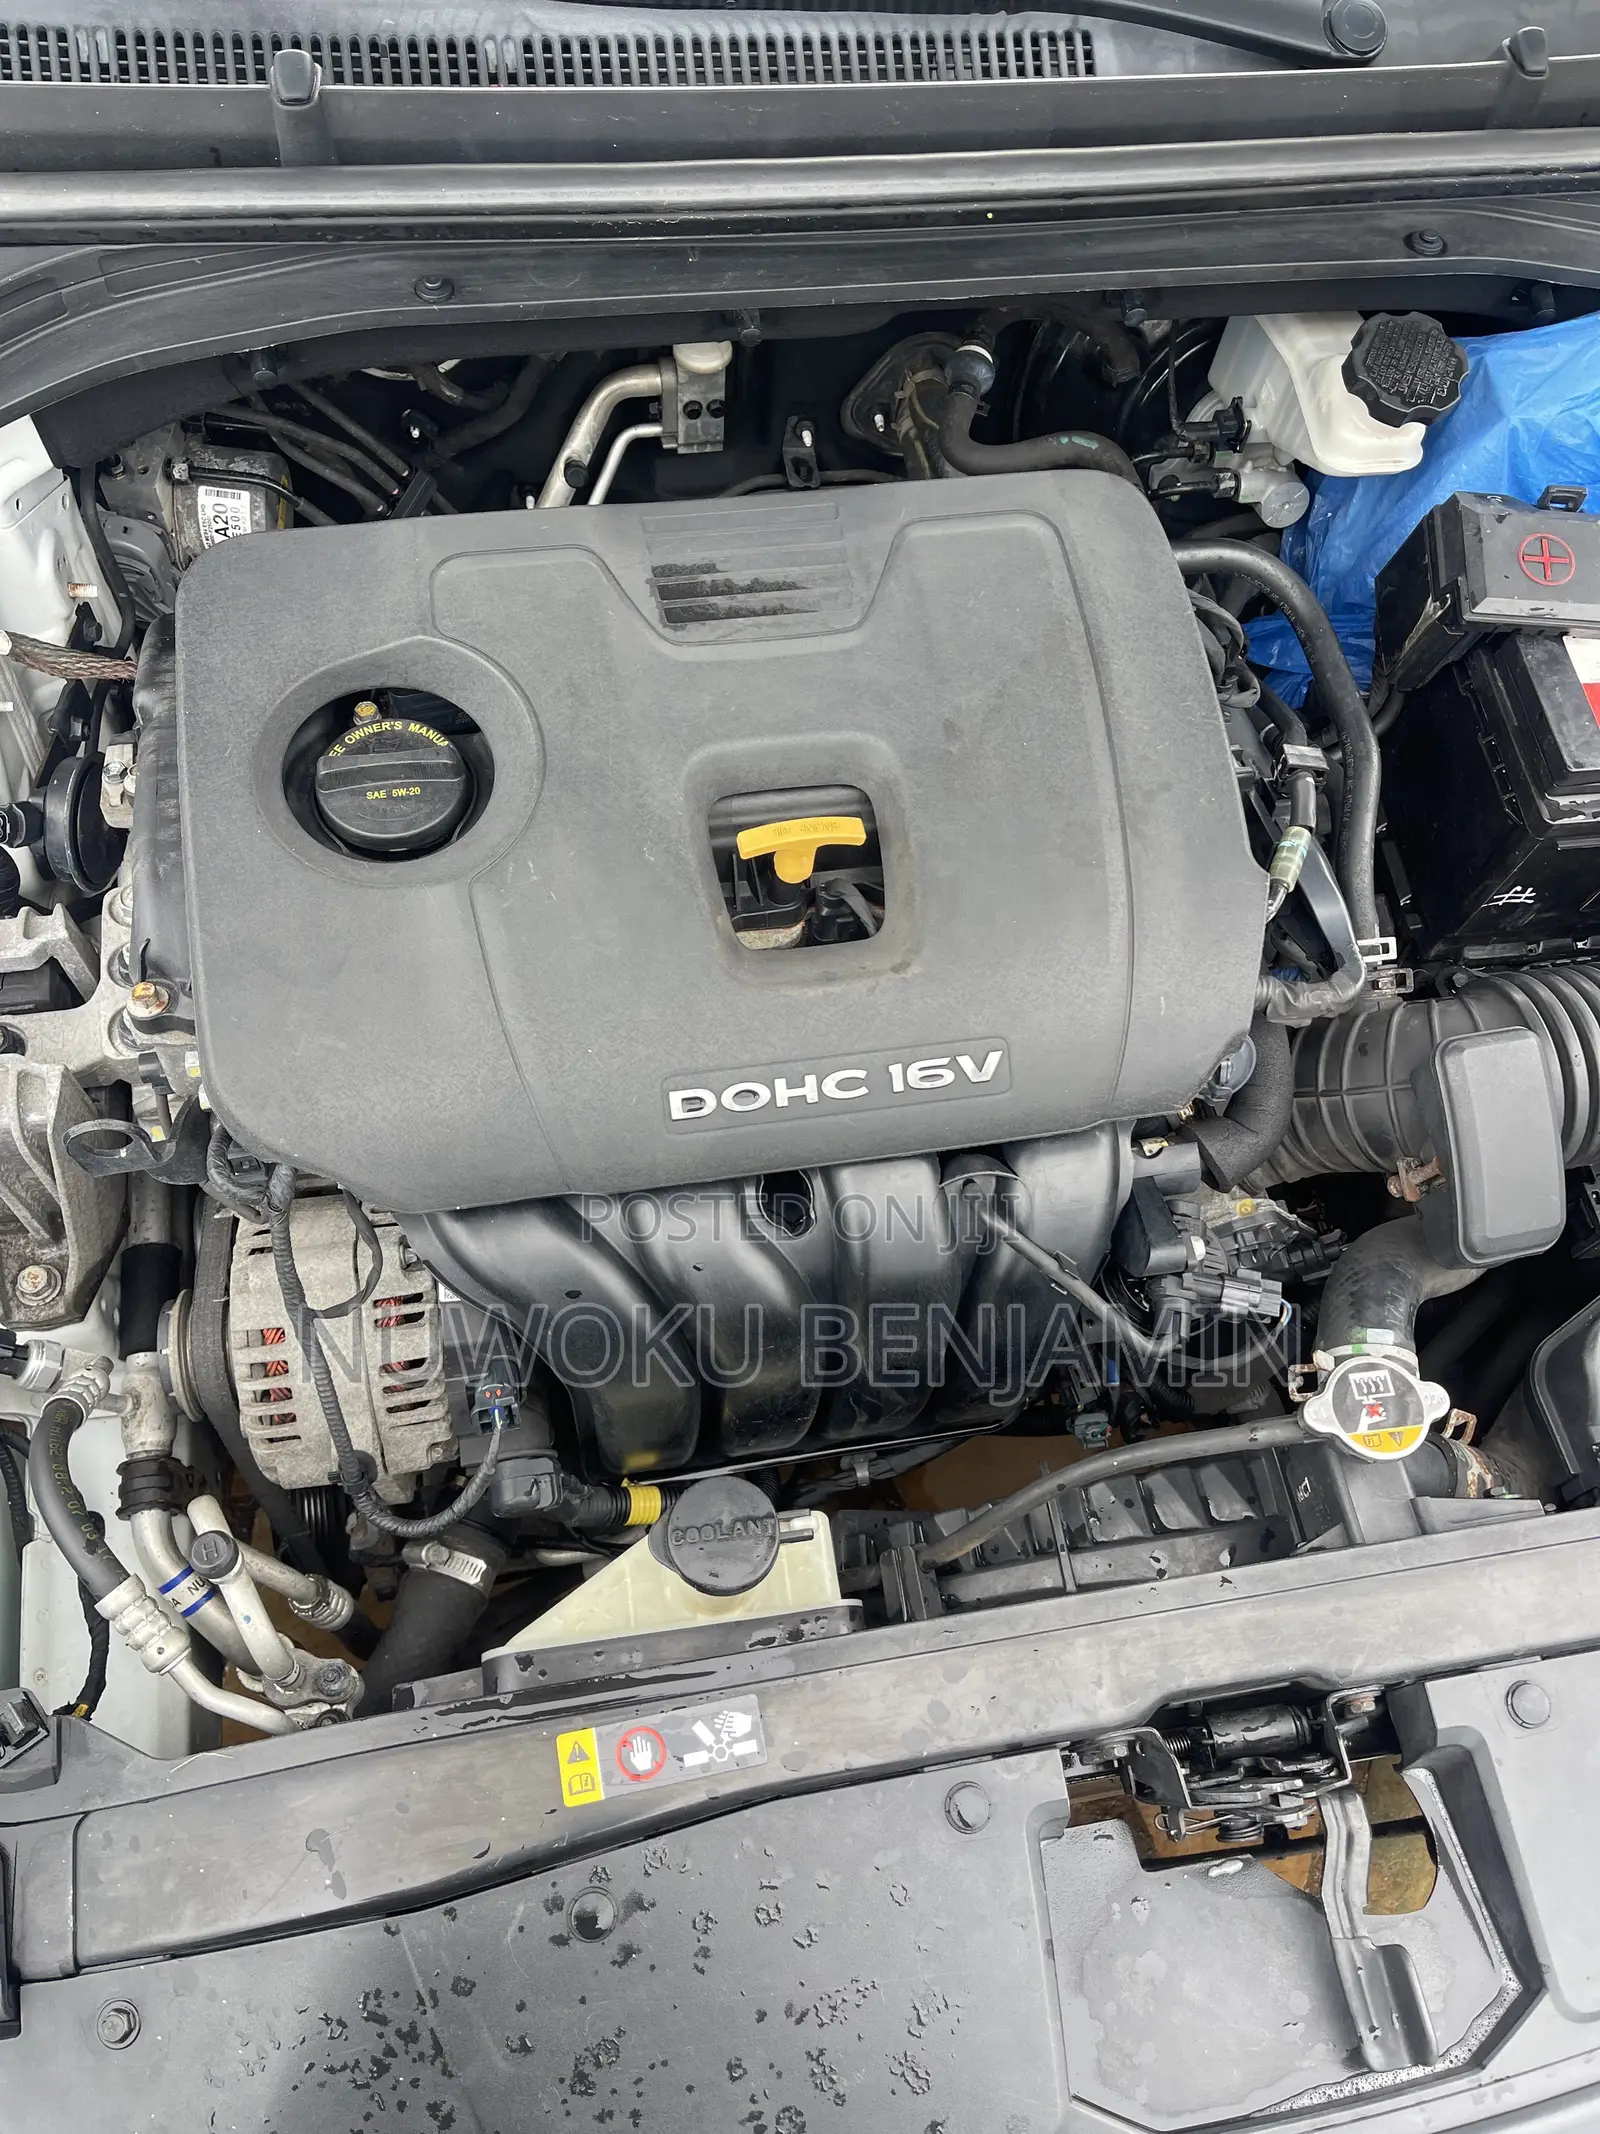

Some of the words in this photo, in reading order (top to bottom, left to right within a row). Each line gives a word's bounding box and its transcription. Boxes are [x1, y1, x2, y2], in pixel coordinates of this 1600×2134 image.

[212, 503, 231, 538] A20
[344, 720, 403, 745] OWNER'S
[408, 722, 450, 748] MANUA
[366, 789, 387, 800] SAE
[392, 786, 421, 798] 5W-20
[668, 1068, 870, 1121] DOHC
[888, 1050, 1003, 1094] 16V
[671, 1517, 776, 1547] COOLANT
[202, 1539, 219, 1561] H
